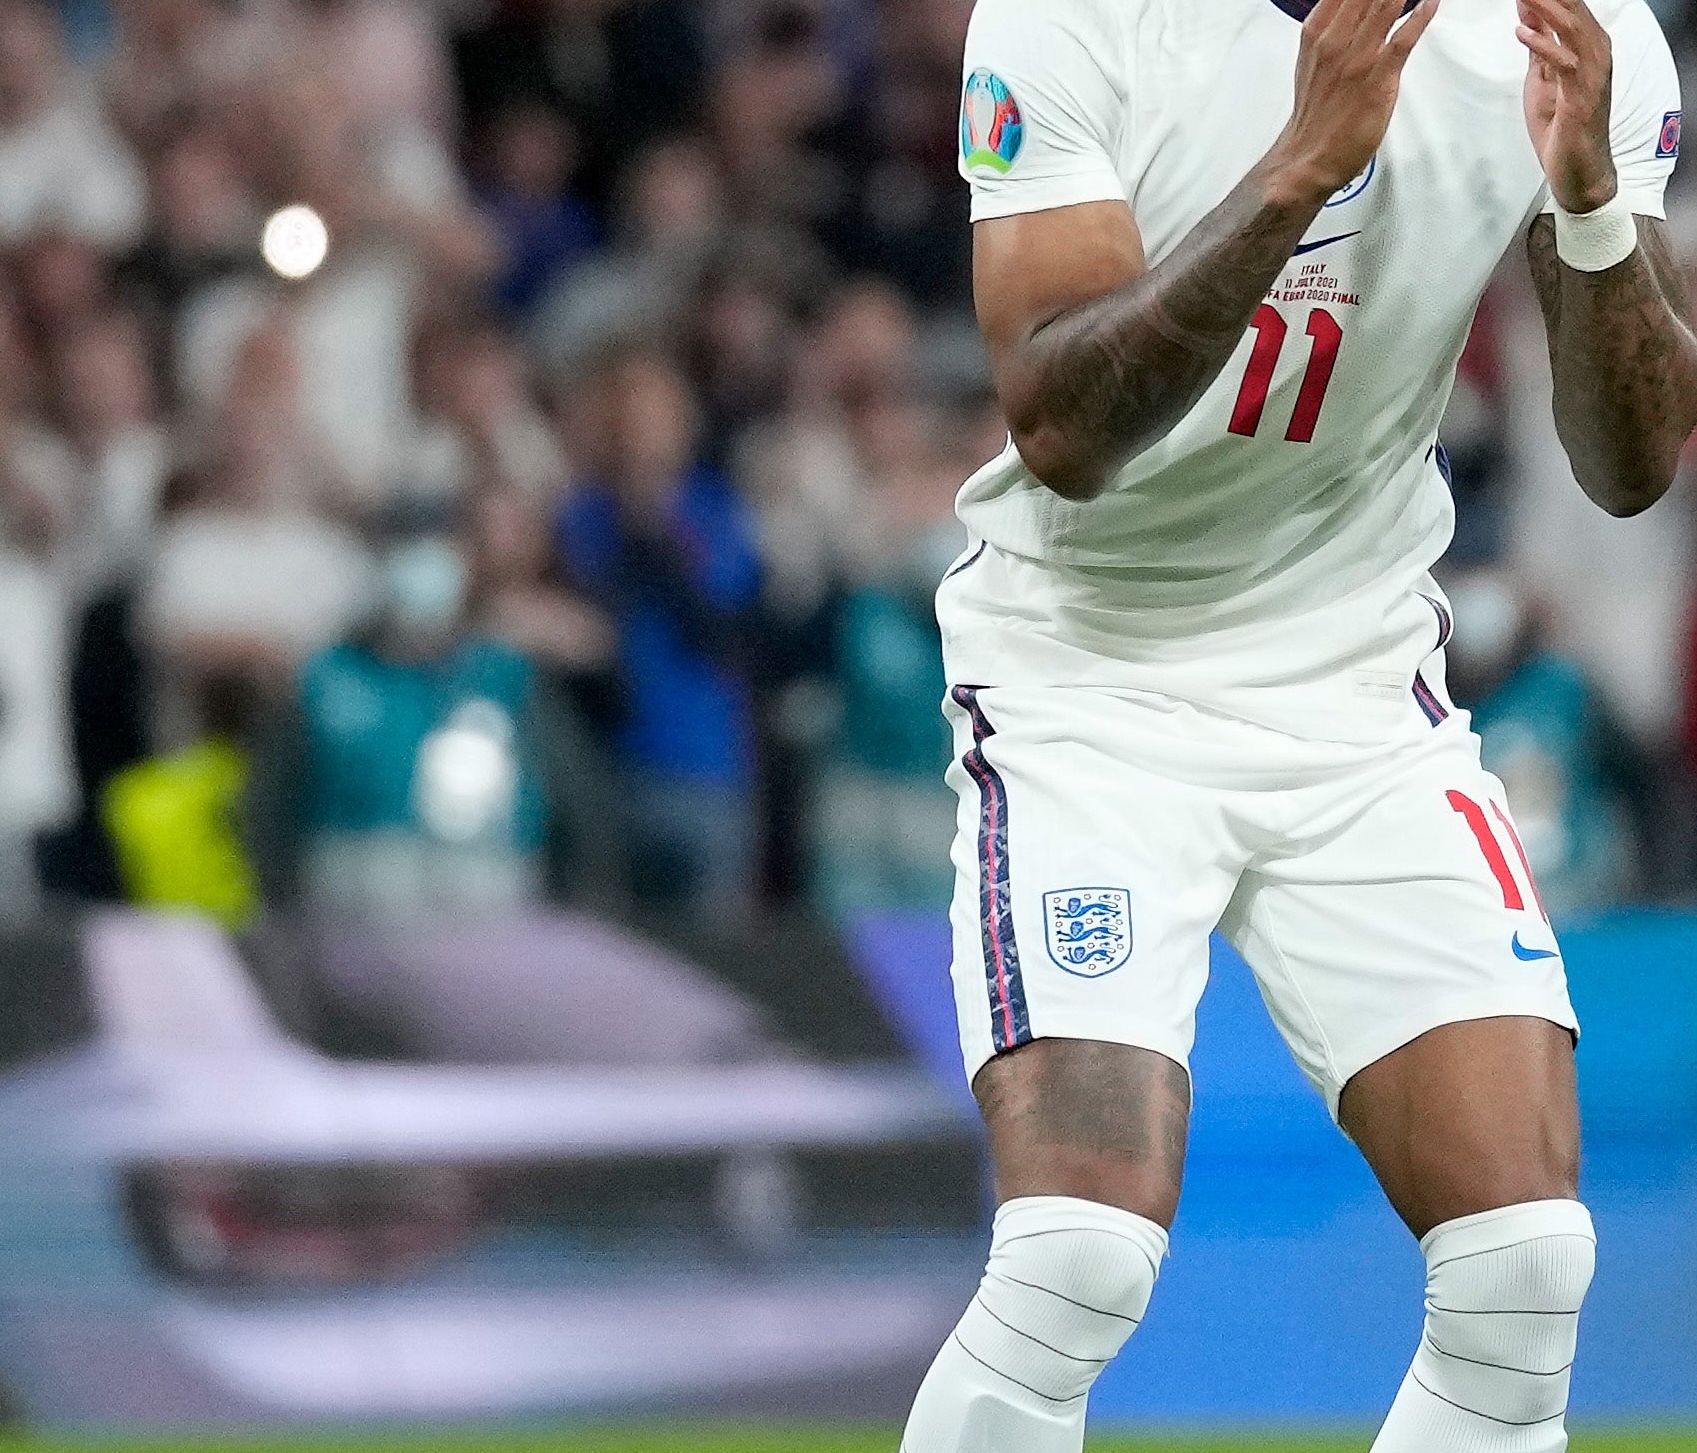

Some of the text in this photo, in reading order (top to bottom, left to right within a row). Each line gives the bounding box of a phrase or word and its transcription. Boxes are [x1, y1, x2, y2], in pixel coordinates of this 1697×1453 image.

[1301, 264, 1327, 275] ITALY
[1285, 276, 1338, 289] 11 JULY 2021
[1267, 288, 1361, 305] FA EURO 2020 FINAL
[1227, 303, 1343, 443] 11
